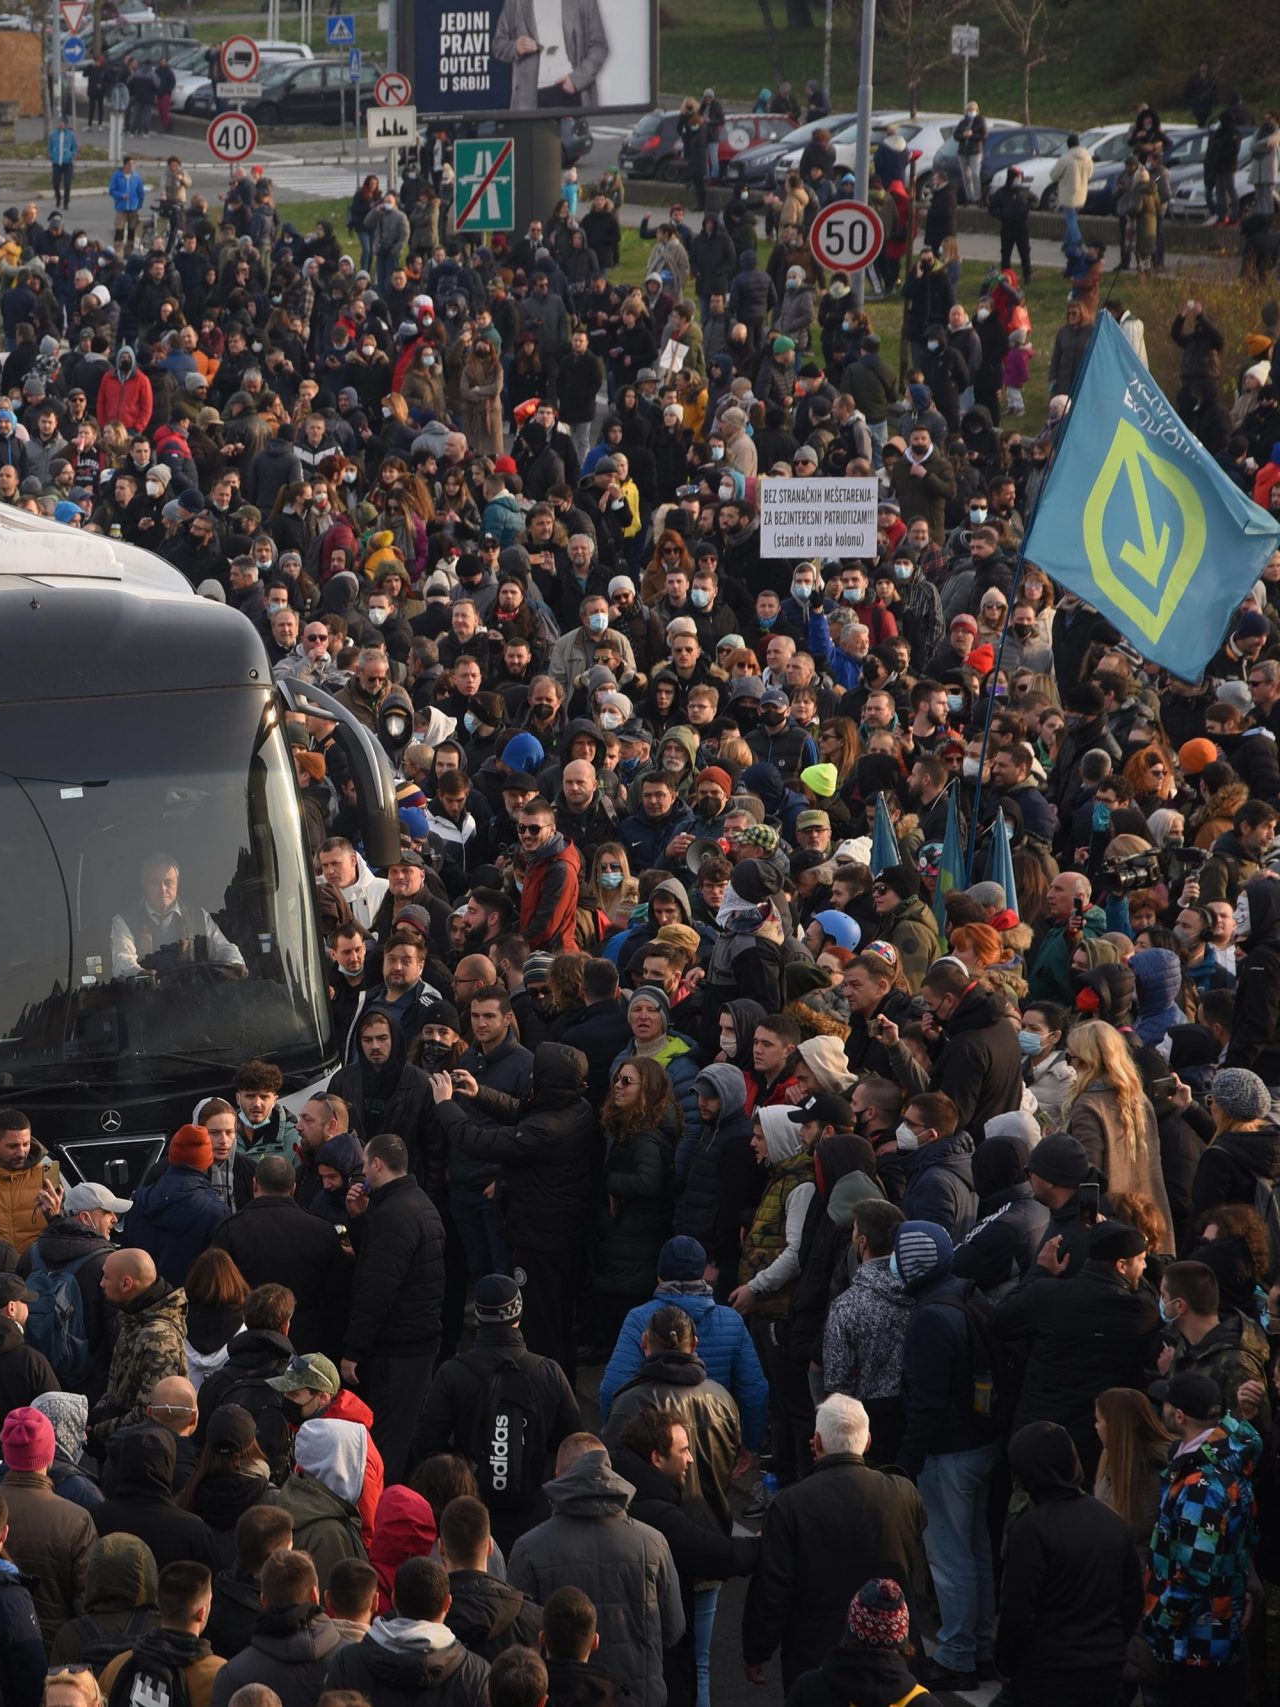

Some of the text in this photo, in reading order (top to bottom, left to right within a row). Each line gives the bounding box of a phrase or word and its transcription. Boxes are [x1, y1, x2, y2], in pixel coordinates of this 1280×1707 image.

[440, 11, 490, 32] JEDINI
[440, 33, 490, 55] PRAVI
[440, 56, 490, 74] OUTLET
[440, 75, 490, 92] U SRBIJI
[217, 125, 246, 150] 40
[826, 220, 868, 255] 50
[764, 489, 777, 503] BEZ
[779, 486, 822, 503] STRANAČKIH
[764, 510, 875, 525] ZA BEZINTERESNI PATRIOTIZAM!!!
[773, 531, 865, 549] (stanite u našu kolonu)
[489, 1414, 509, 1491] adidas
